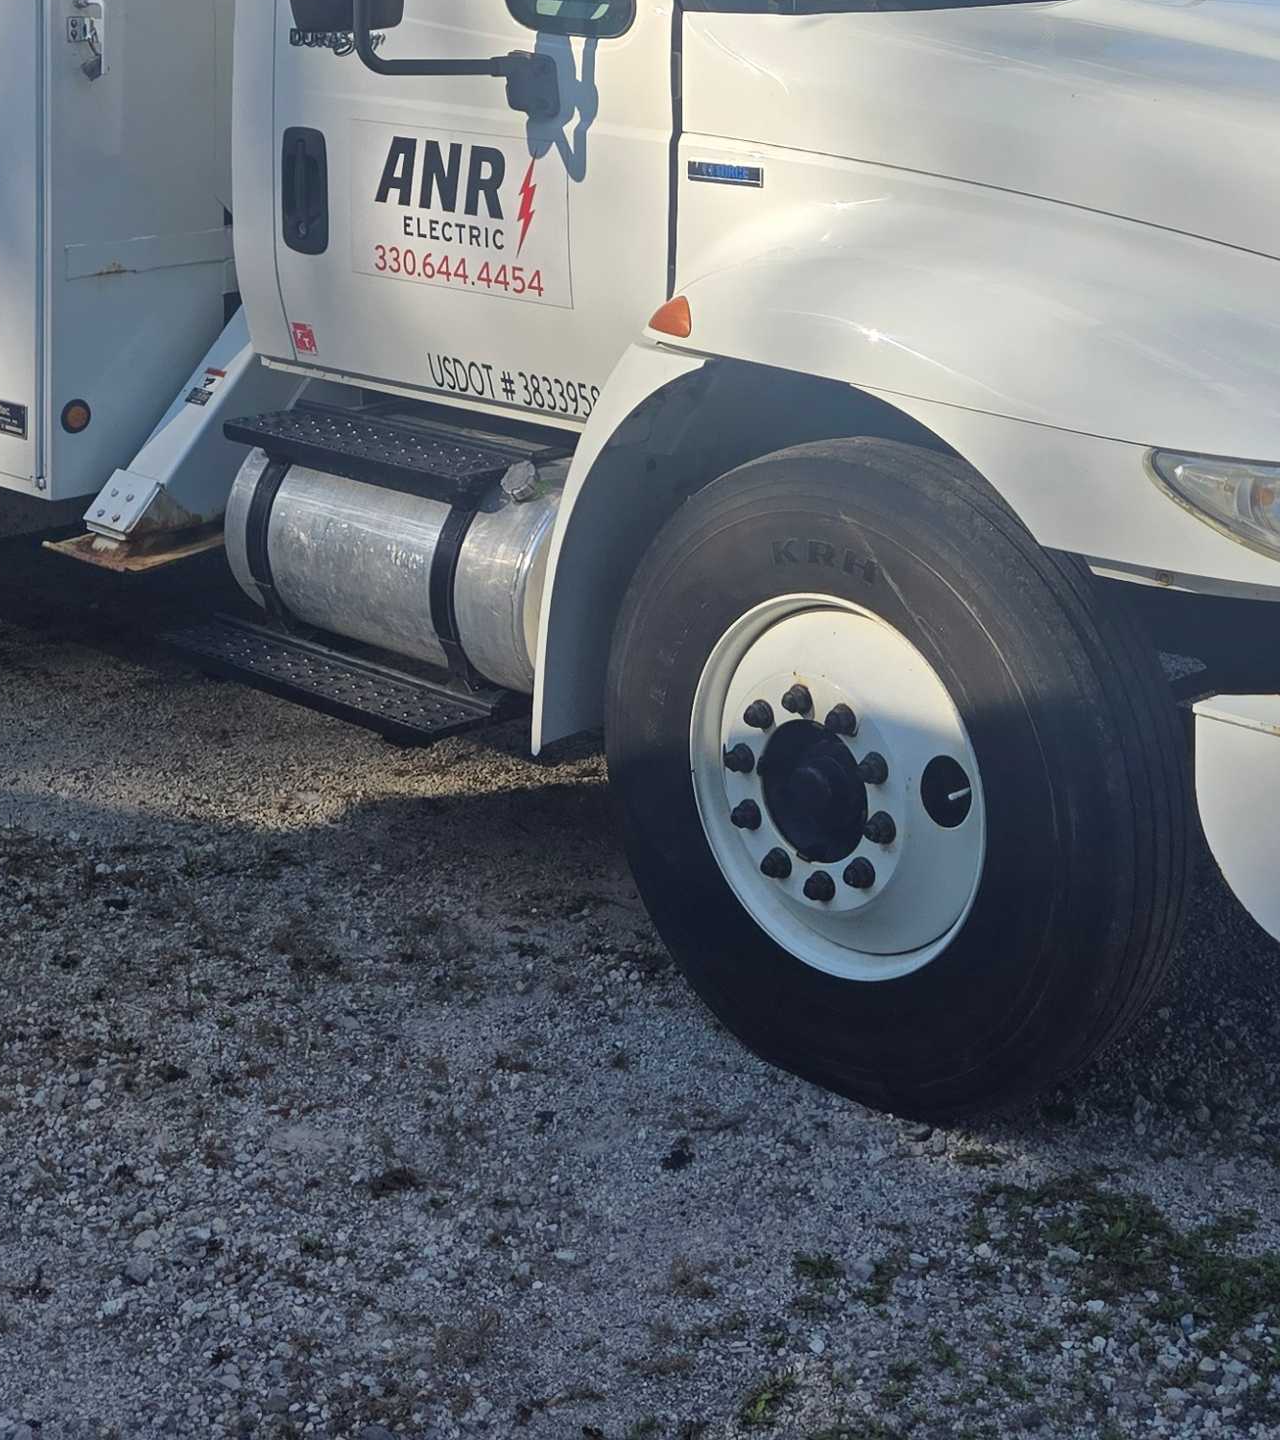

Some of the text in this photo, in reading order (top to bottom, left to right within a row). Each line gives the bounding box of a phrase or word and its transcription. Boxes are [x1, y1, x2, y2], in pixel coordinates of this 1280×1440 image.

[375, 136, 506, 220] ANR
[403, 215, 505, 250] ELECTRIC
[374, 245, 545, 297] 330.644.4454
[427, 353, 496, 399] USDOT
[500, 371, 516, 401] #
